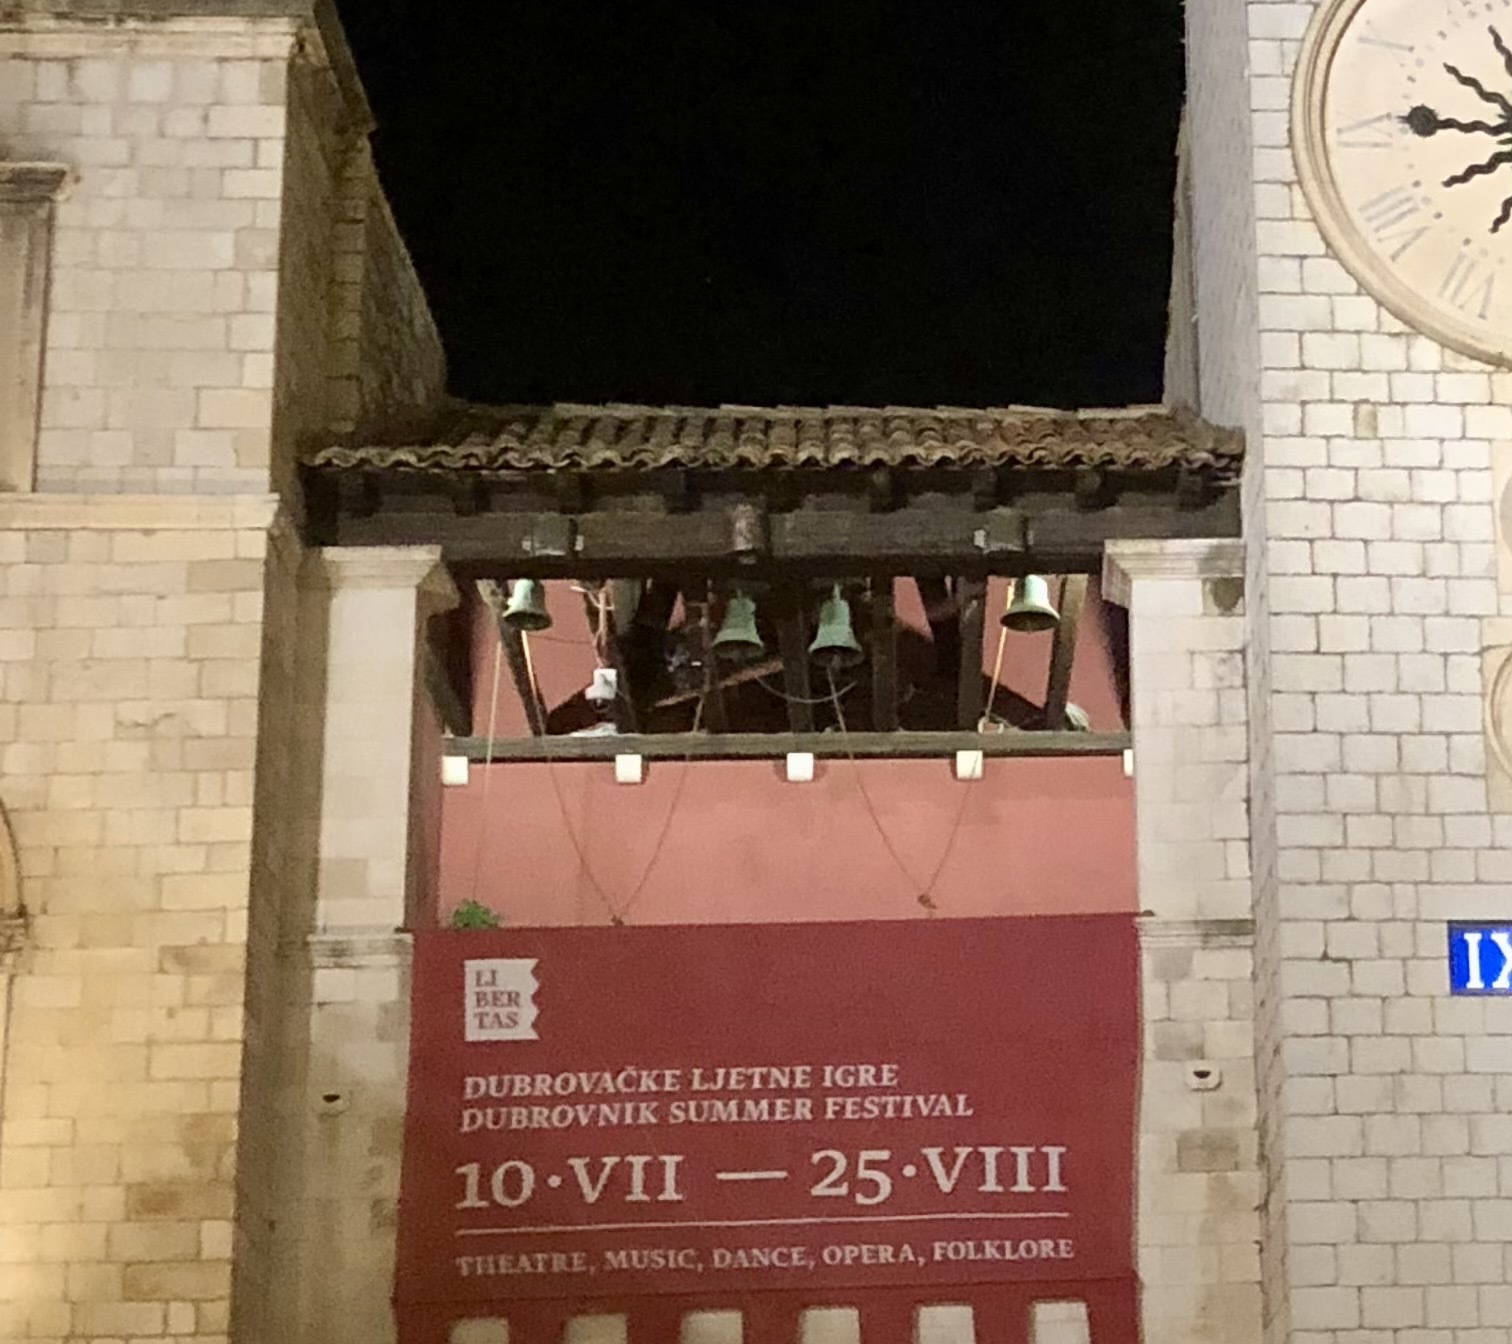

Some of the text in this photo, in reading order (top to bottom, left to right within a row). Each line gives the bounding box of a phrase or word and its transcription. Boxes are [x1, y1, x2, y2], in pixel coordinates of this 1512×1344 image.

[475, 969, 498, 987] LI
[474, 991, 520, 1008] BER
[474, 1011, 519, 1030] TAS
[463, 1063, 899, 1100] DUBROVAČKE LJETNE IGRE
[461, 1093, 974, 1133] DUBROVNIK SUMMER FESTIVAL
[456, 1239, 1074, 1277] THEATRE, MUSIC, DANCE, OPERA, FOLKLORE
